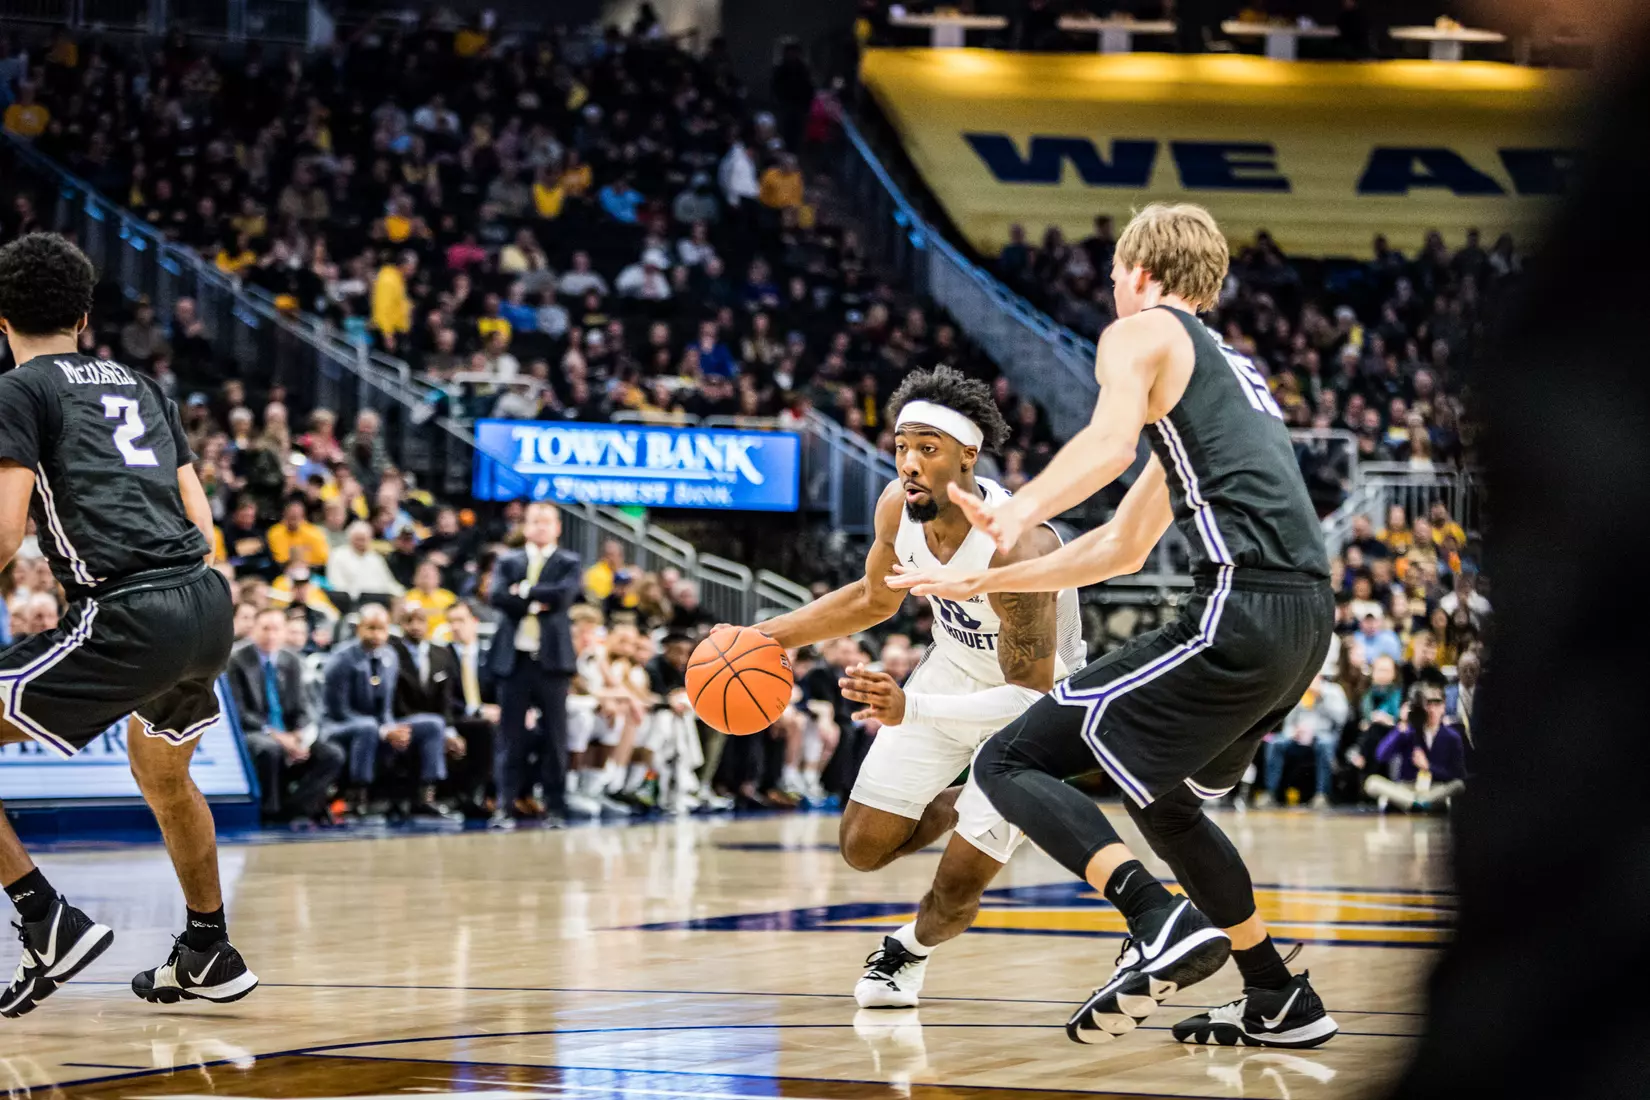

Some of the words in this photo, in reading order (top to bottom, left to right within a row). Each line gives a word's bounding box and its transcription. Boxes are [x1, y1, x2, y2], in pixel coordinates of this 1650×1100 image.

[961, 132, 1292, 193] WE
[1356, 146, 1583, 197] AR
[100, 393, 160, 467] 2
[512, 425, 640, 467] TOWN
[646, 430, 763, 485] BANK
